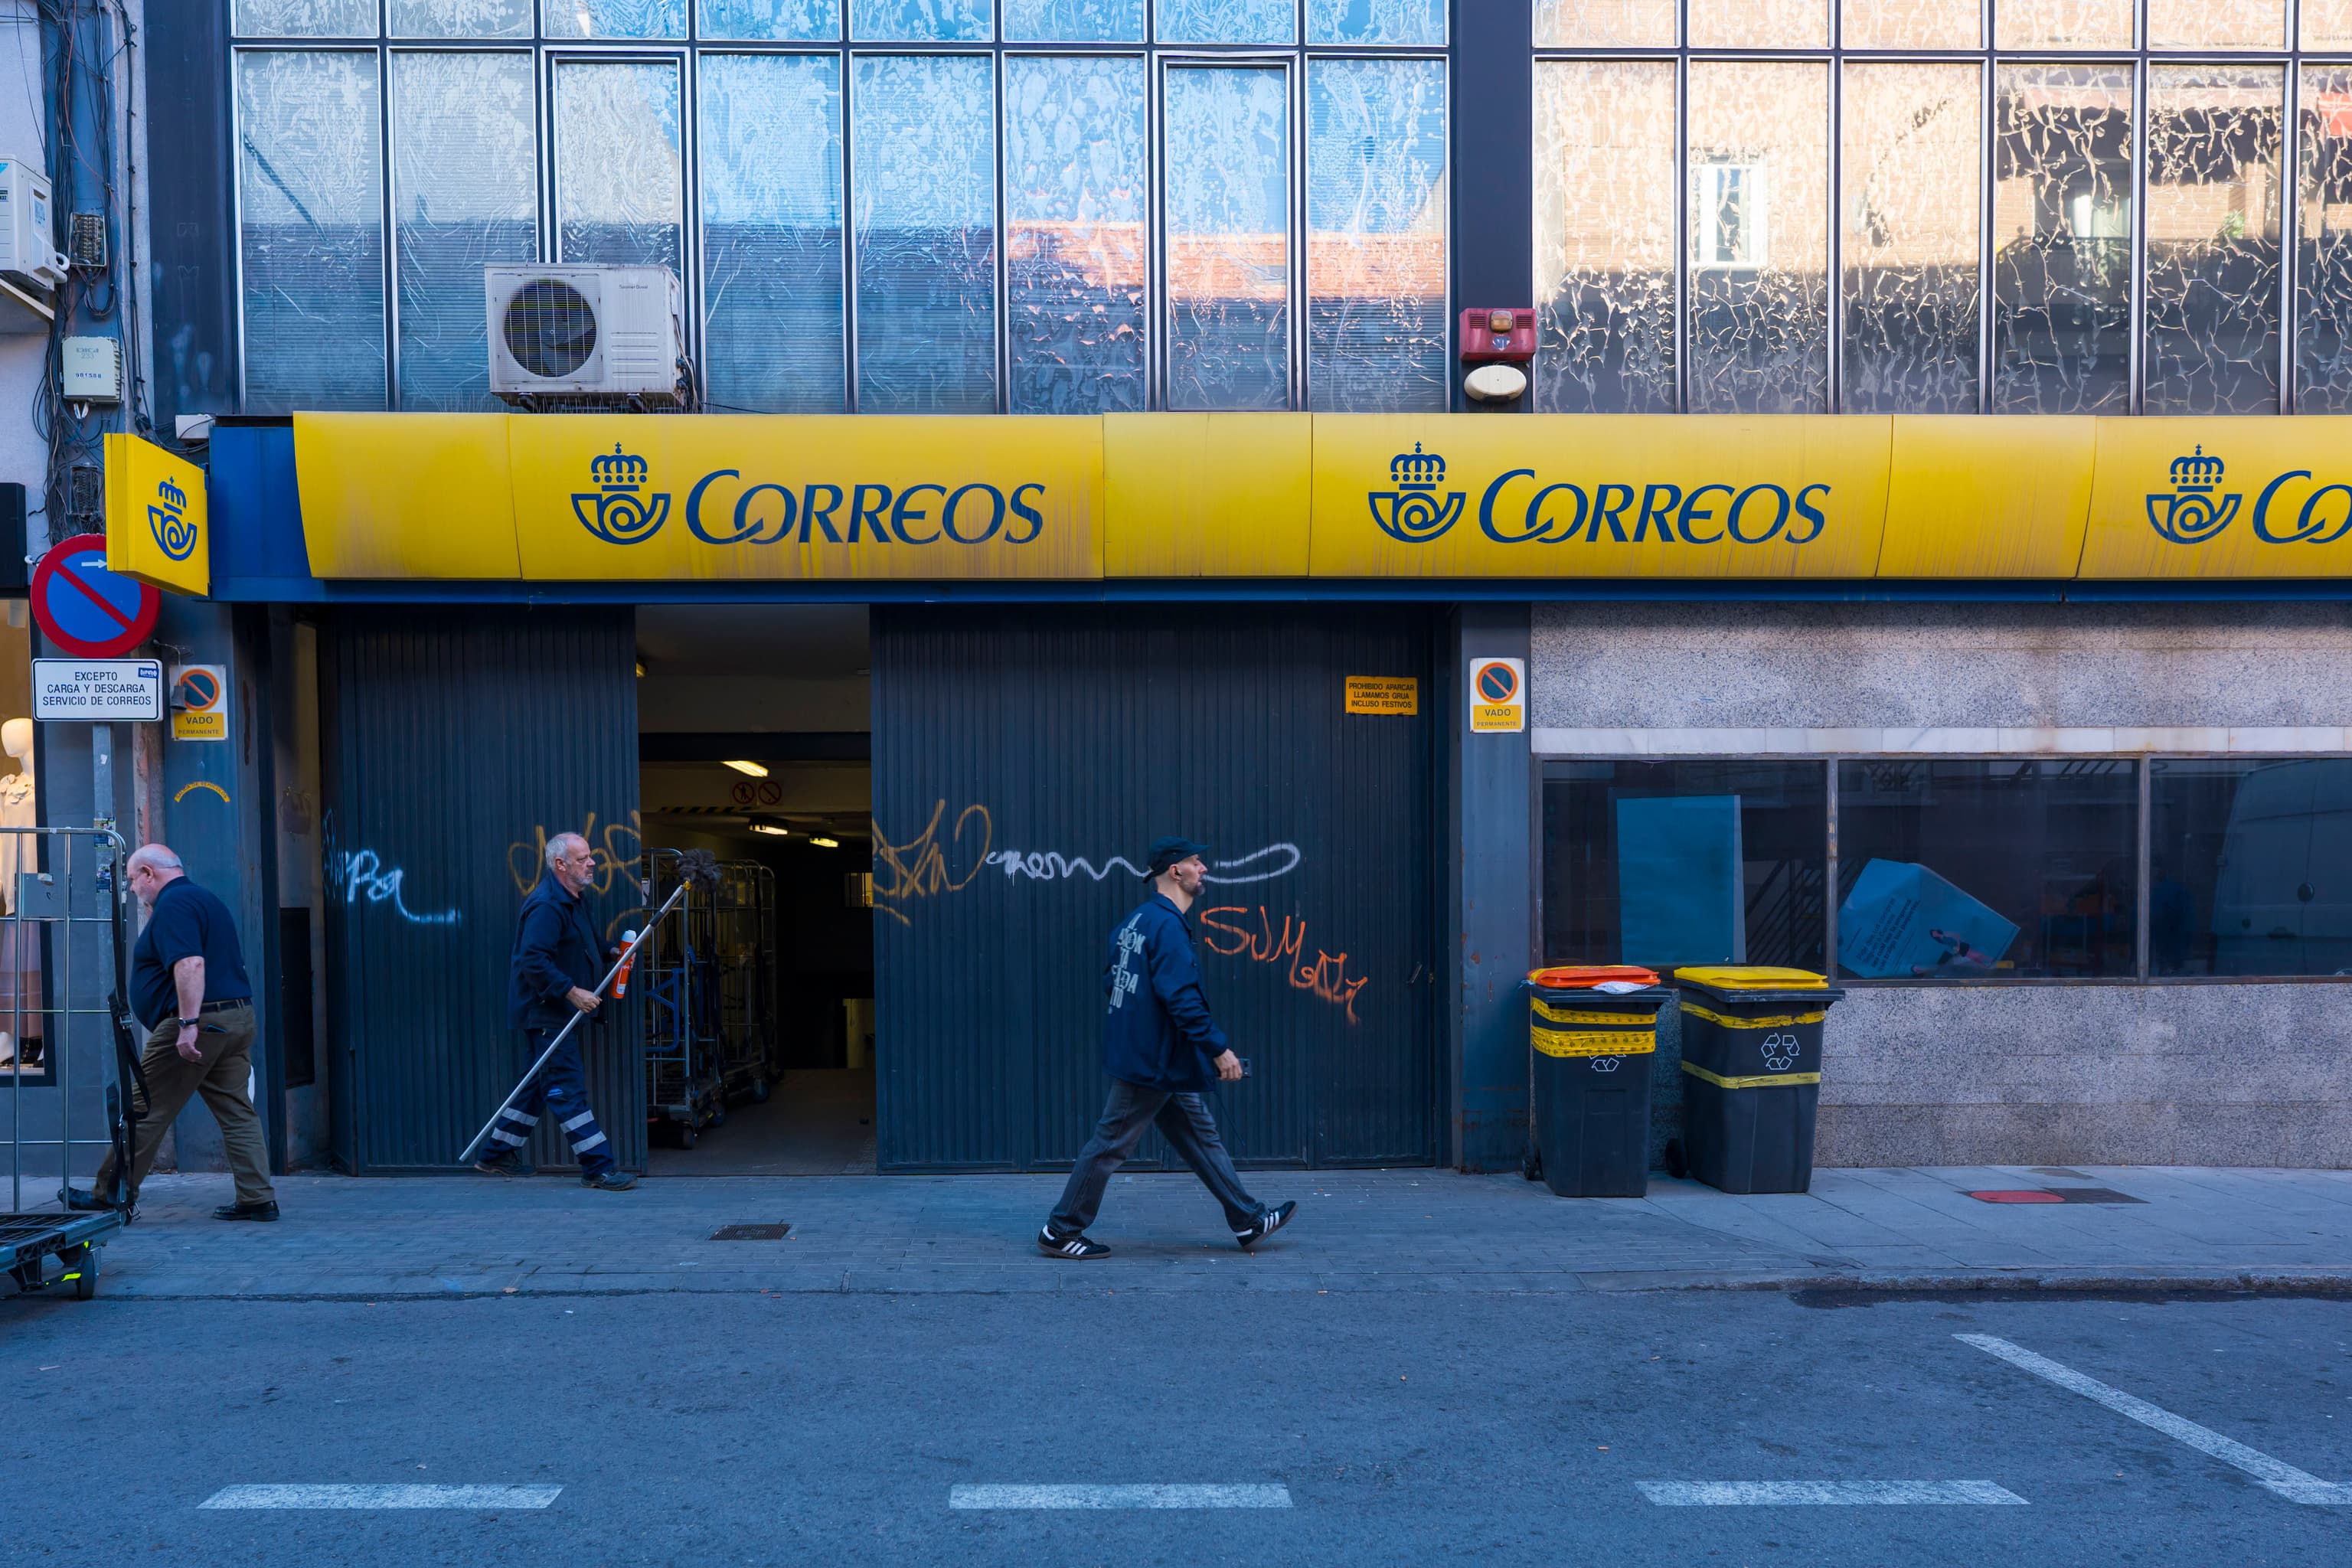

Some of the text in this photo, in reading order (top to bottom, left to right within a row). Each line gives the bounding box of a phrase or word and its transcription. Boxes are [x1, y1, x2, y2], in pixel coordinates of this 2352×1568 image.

[685, 469, 1046, 545] CORREOS
[1478, 469, 1831, 544] CORREOS
[75, 671, 118, 681] EXCEPTO
[47, 684, 145, 694] CARGA Y DESCARGA
[43, 696, 152, 706] SERVICIO DE CORREOS
[1485, 708, 1511, 717] VADO
[185, 716, 214, 724] VADO
